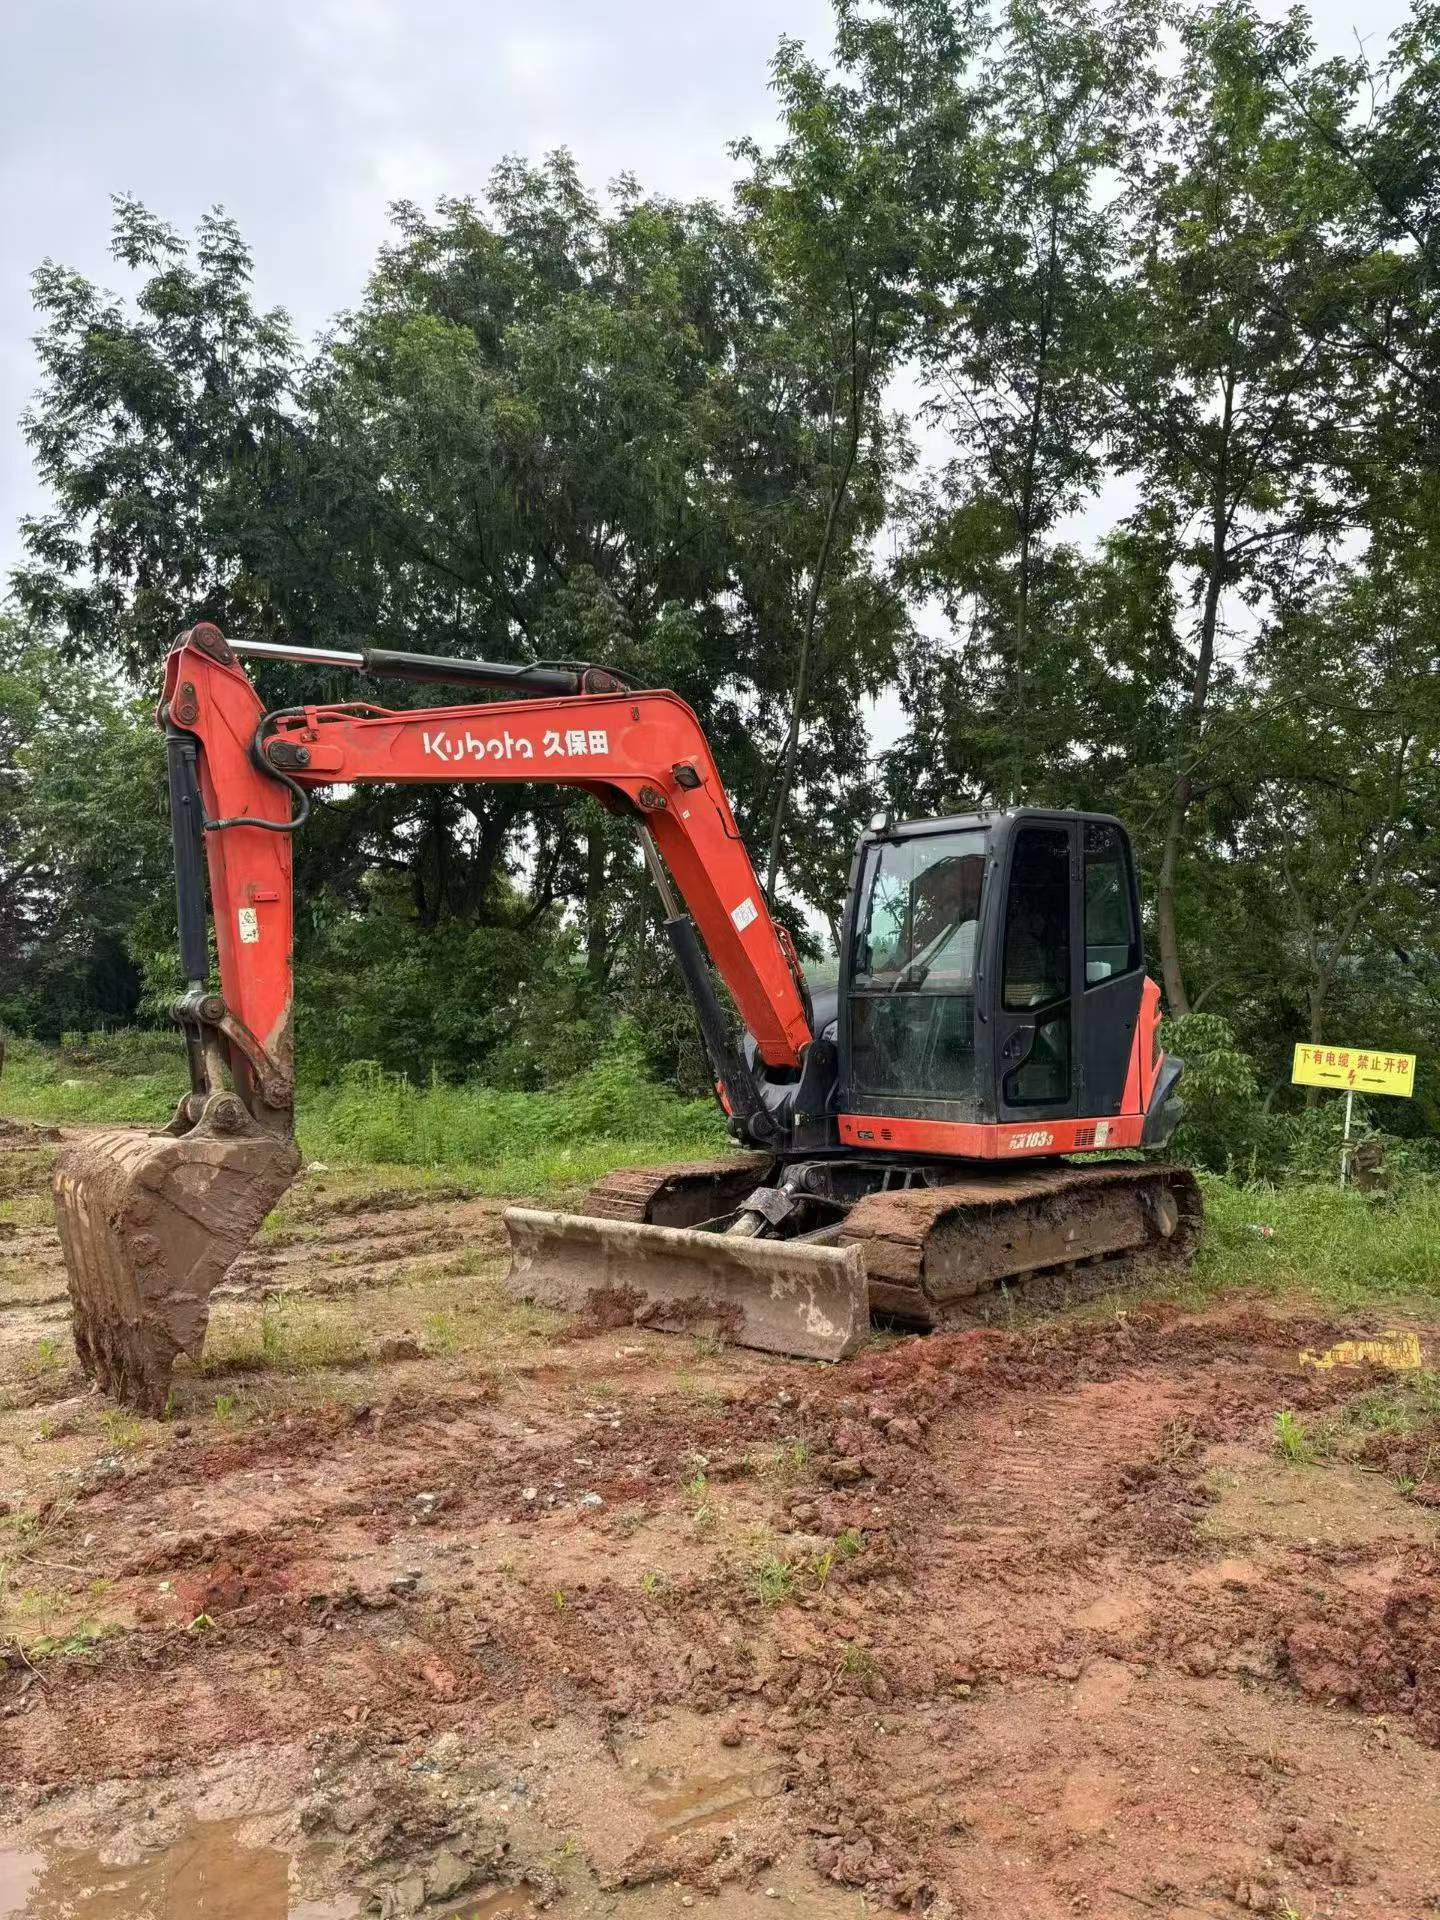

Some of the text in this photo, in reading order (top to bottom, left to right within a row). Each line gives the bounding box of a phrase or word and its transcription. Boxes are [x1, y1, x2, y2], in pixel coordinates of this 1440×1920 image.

[422, 730, 609, 761] Kubota 久保田
[1301, 1048, 1409, 1074] 下有电缆 禁止开挖
